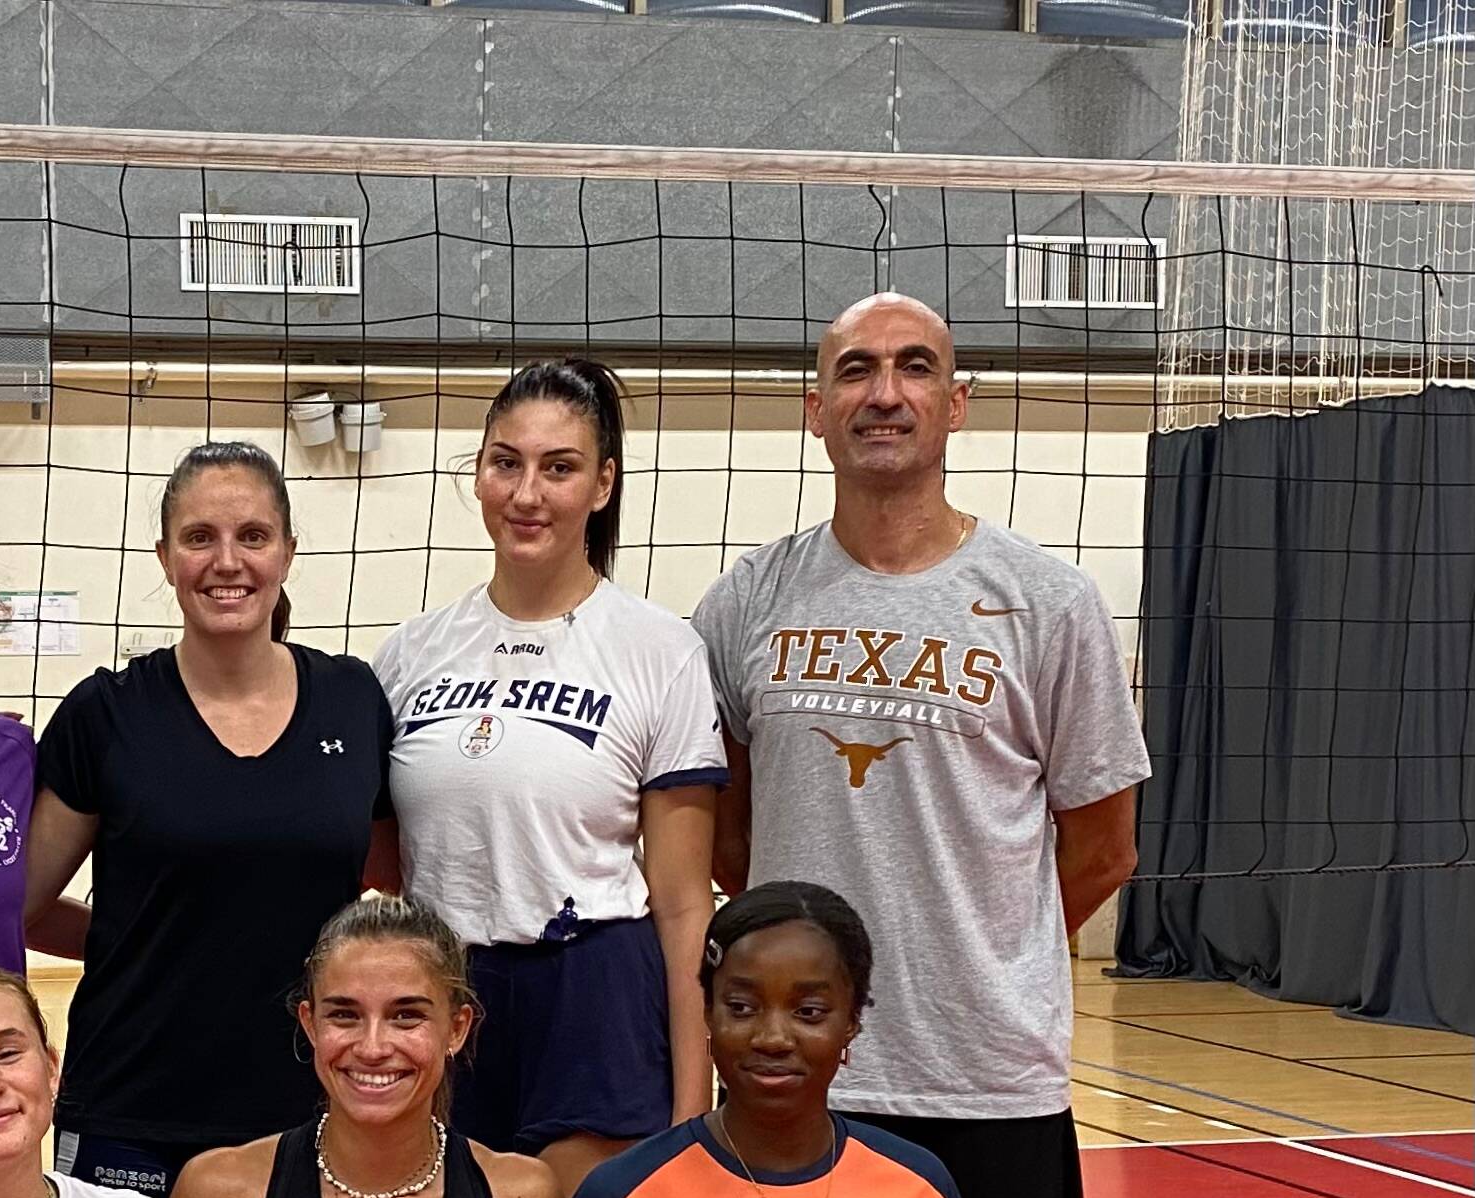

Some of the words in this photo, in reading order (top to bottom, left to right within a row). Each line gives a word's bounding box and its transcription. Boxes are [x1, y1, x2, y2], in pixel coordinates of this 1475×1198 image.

[510, 643, 545, 656] ARDU
[767, 627, 1004, 707] TEXAS
[412, 677, 498, 716] GŽOK
[501, 679, 612, 727] SREM
[791, 693, 942, 724] VOLLEYBALL
[94, 1166, 166, 1185] panzeri
